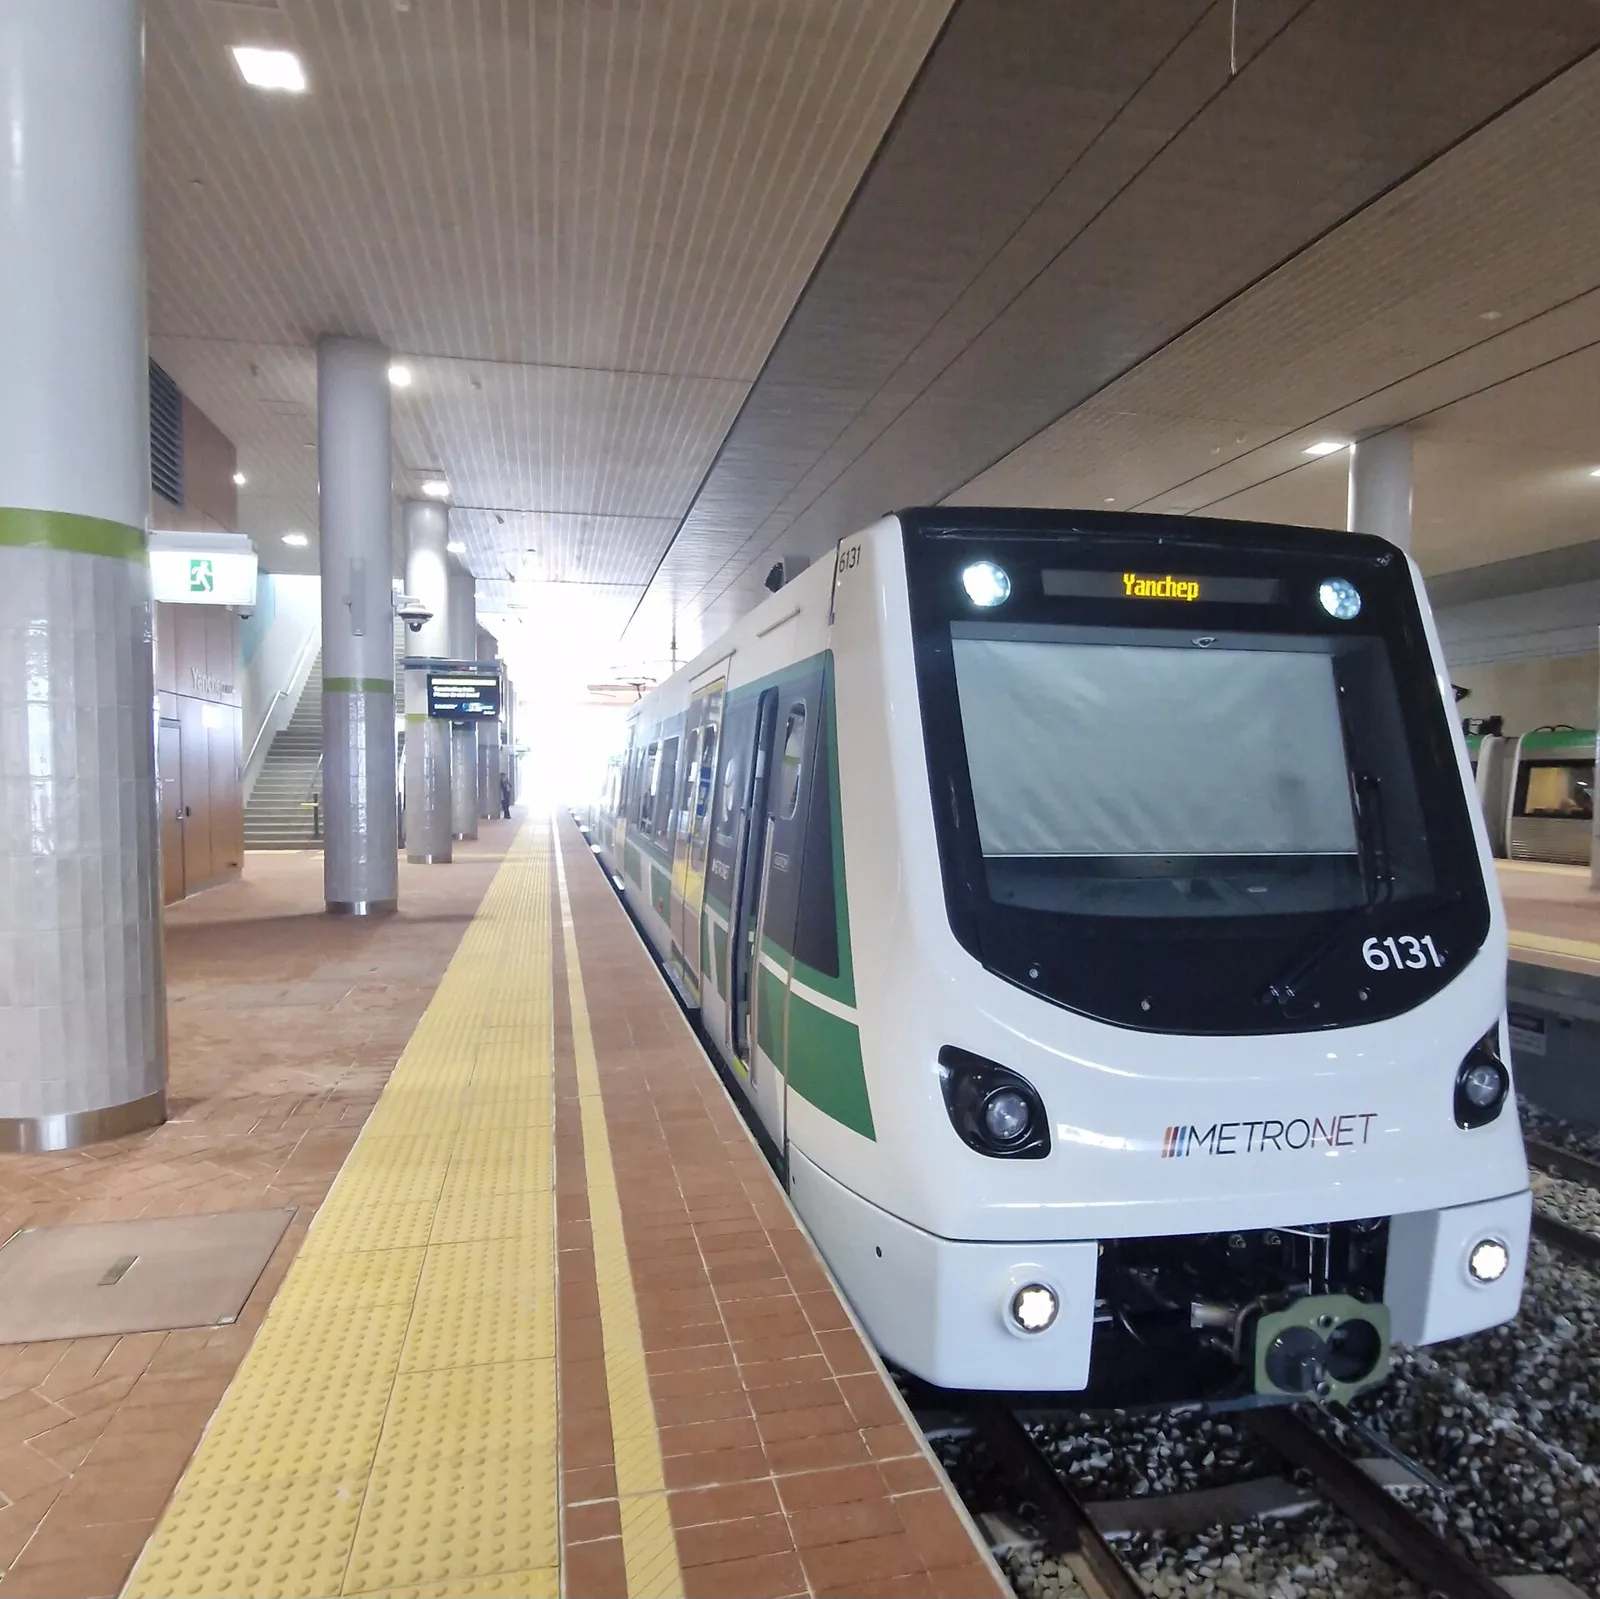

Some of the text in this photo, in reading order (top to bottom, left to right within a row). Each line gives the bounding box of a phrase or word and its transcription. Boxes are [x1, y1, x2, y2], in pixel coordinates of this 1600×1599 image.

[839, 545, 861, 573] 6131
[1123, 573, 1199, 601] Yanchep
[1362, 935, 1442, 971] 6131
[1186, 1113, 1378, 1156] METRONET
